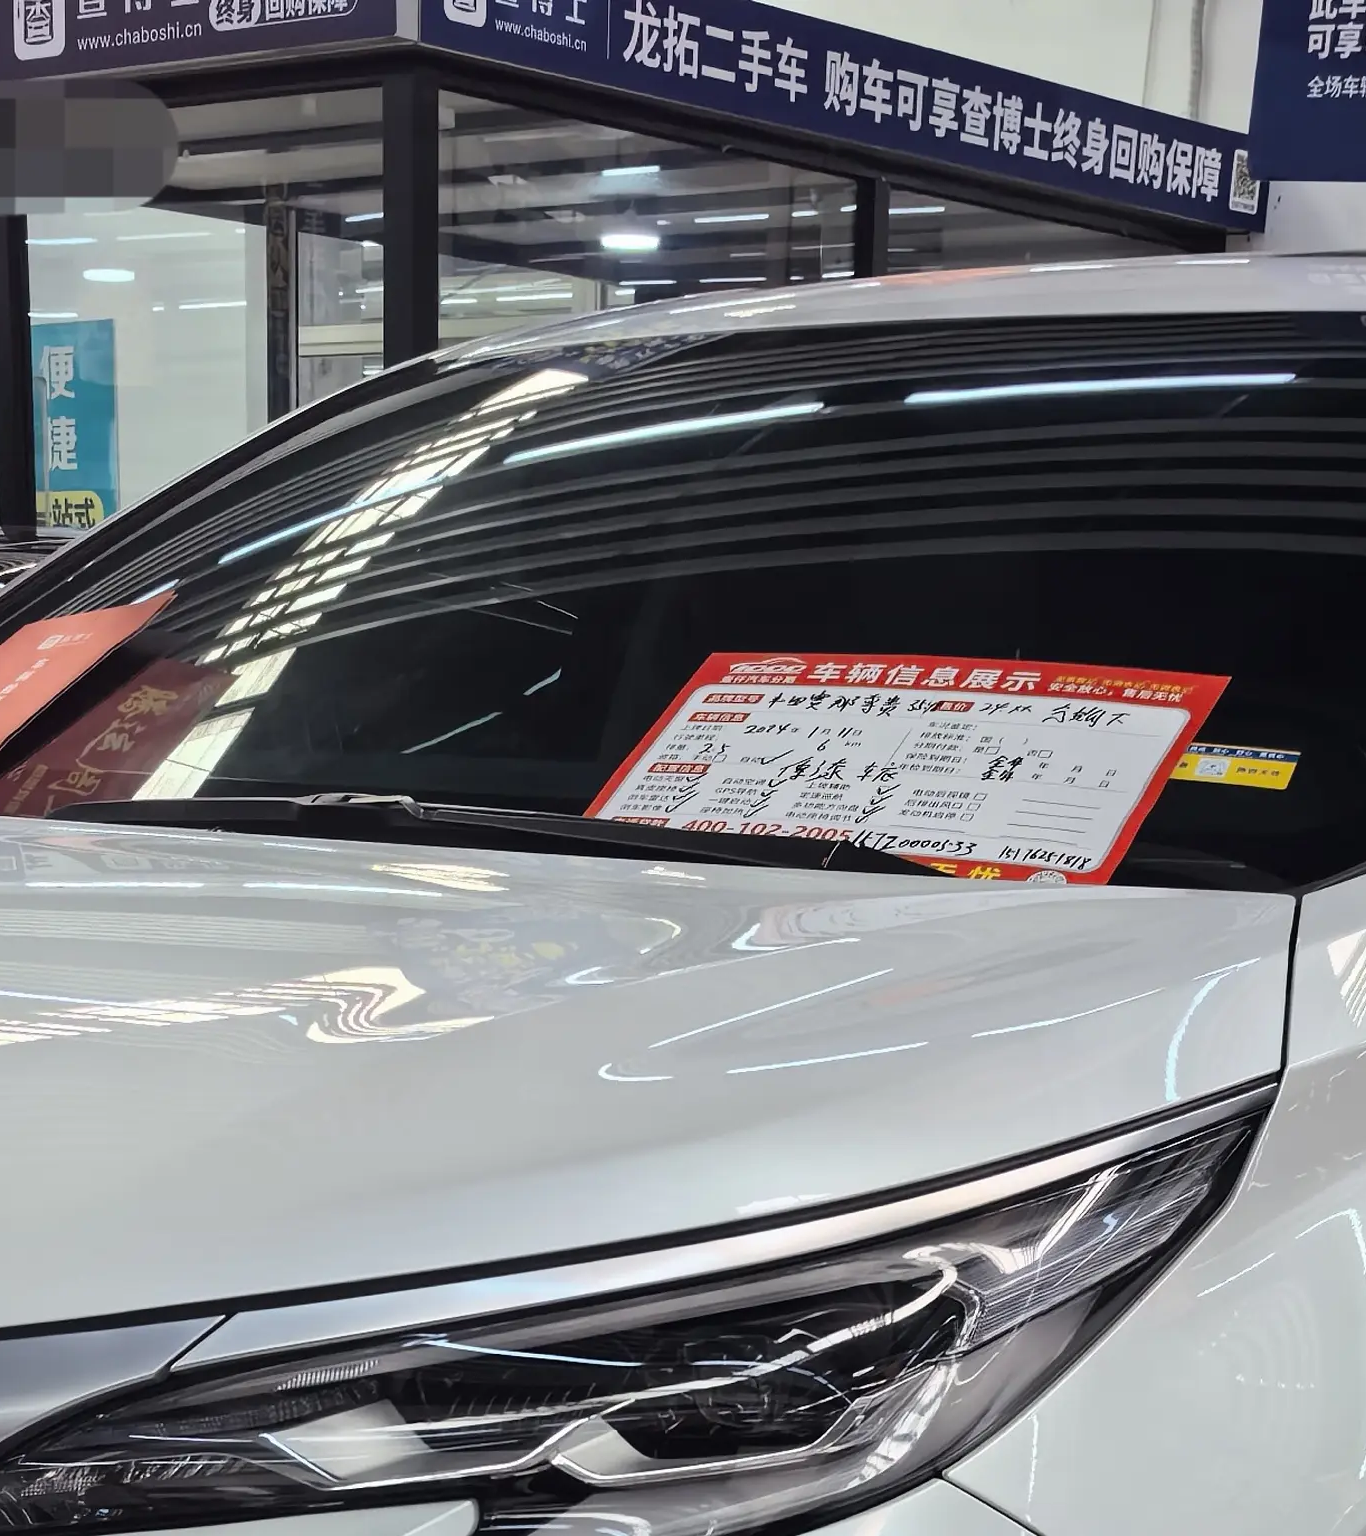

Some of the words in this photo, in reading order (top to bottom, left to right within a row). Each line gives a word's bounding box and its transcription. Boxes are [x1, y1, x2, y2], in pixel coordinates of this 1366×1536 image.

[76, 21, 203, 51] www.chaboshi.cn
[495, 18, 587, 52] www.chaboshi.cn
[1307, 22, 1365, 60] 可享
[623, 2, 808, 103] 龙拓二手车
[823, 50, 1223, 203] 购车可享查博士终身回购保障
[807, 662, 1041, 693] 车辆信息展示
[691, 712, 747, 723] 车辆信息
[682, 818, 855, 842] 400-102-2005
